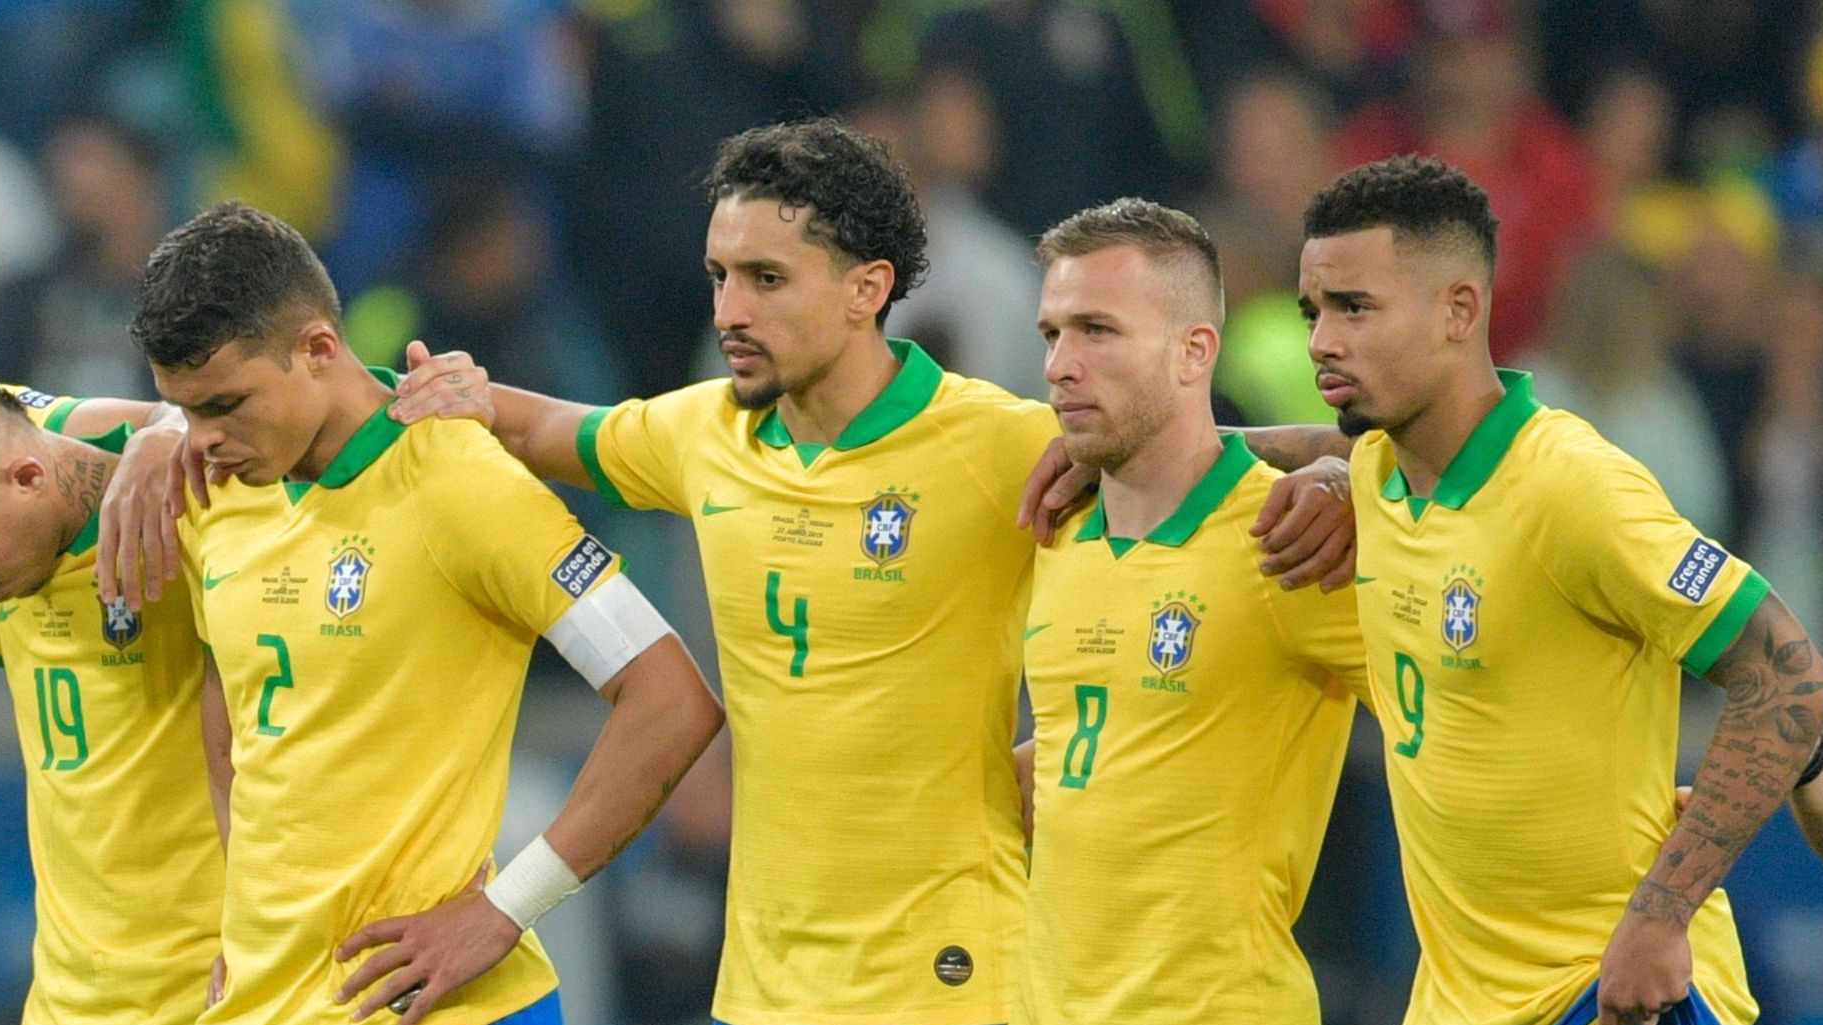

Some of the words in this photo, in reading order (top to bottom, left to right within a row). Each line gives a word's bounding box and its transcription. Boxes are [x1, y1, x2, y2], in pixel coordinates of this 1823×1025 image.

[877, 523, 894, 533] CBF
[556, 553, 586, 582] Cree
[582, 540, 598, 556] en
[568, 551, 606, 595] grande
[853, 567, 906, 583] BRASIL
[1672, 560, 1698, 590] Cree
[1693, 543, 1710, 561] en
[1686, 553, 1720, 600] grande
[320, 623, 365, 638] BRASIL
[765, 570, 809, 678] 4
[100, 652, 146, 667] BRASIL
[255, 633, 295, 737] 2
[1141, 676, 1190, 694] BRASIL
[1394, 651, 1425, 759] 9
[34, 667, 89, 771] 19
[1058, 684, 1109, 790] 8
